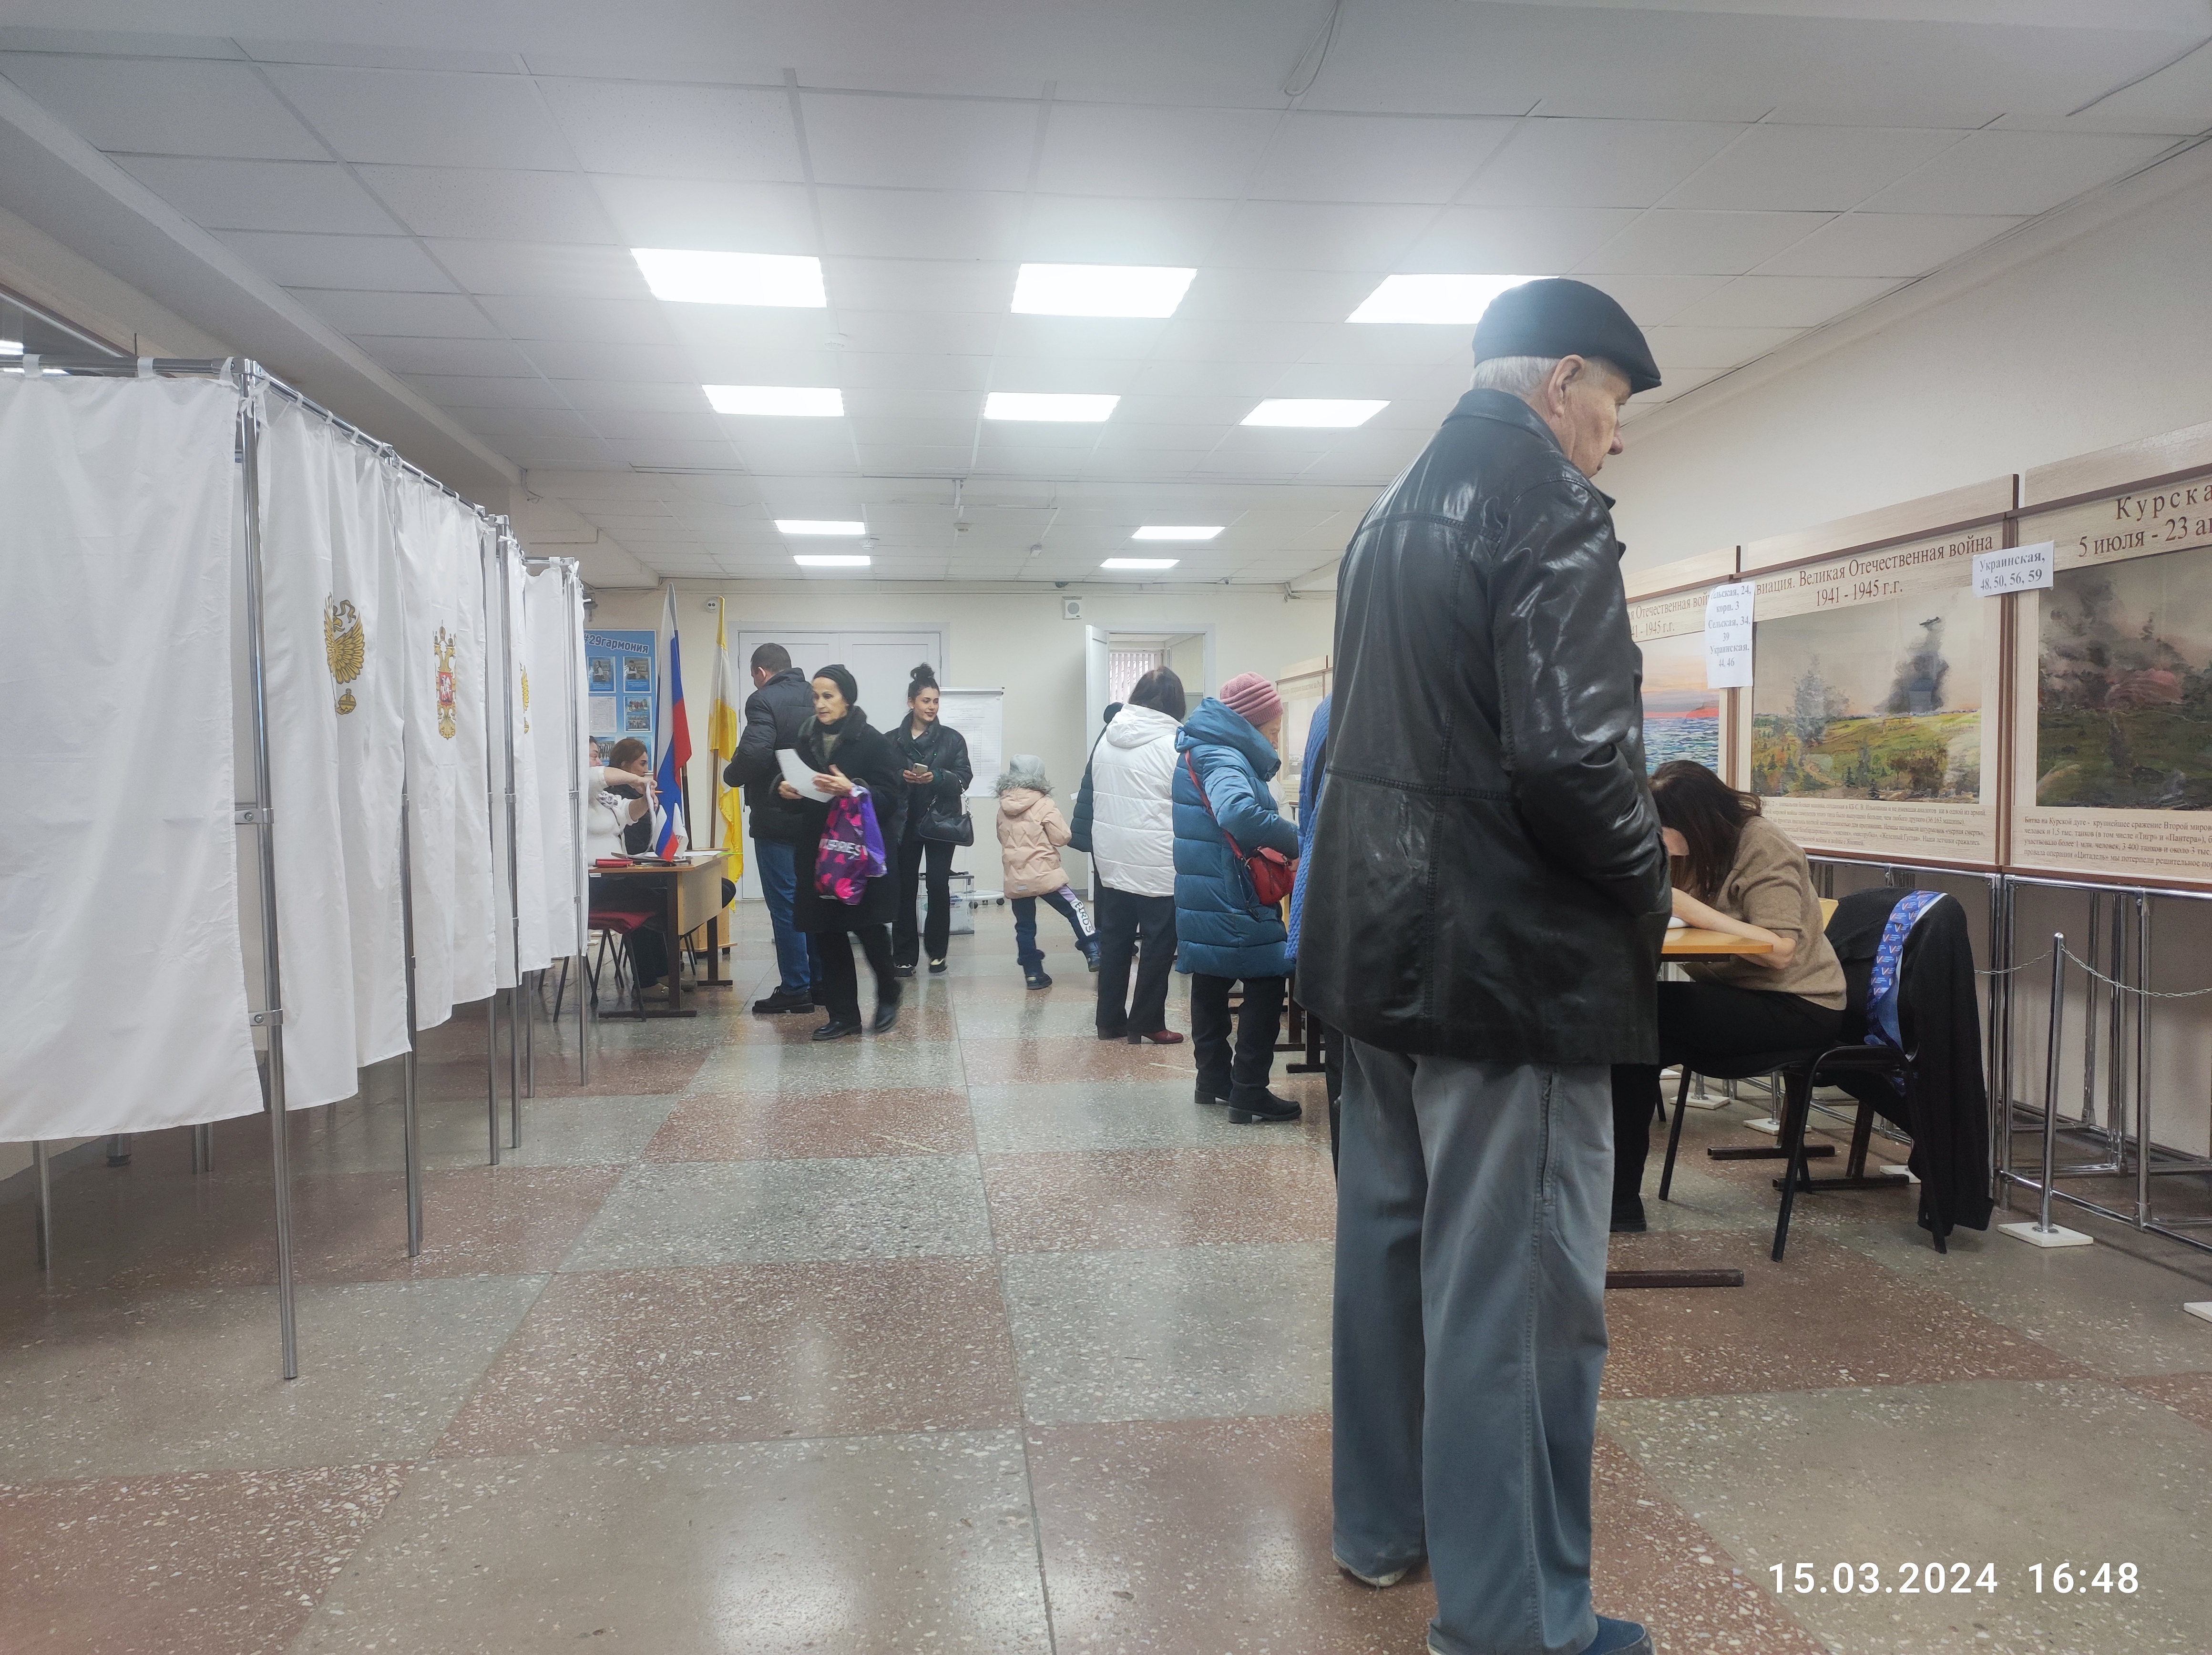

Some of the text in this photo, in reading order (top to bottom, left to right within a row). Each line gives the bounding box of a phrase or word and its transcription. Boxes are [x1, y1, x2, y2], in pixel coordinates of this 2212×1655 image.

[2078, 536, 2087, 557] 5
[2094, 531, 2144, 554] июля
[2165, 516, 2187, 542] 23
[1755, 535, 1993, 595] виация. Великая Отечественная война
[1979, 550, 2045, 573] Украинская,
[1980, 569, 2043, 591] 48, 50, 56, 59
[1741, 585, 1751, 595] 24,
[1816, 586, 1840, 607] 1941
[1854, 580, 1879, 600] 1945
[1883, 581, 1903, 595] г.г.
[1636, 598, 1690, 619] Отечественная
[1735, 601, 1739, 610] 3
[1646, 620, 1661, 636] 1945
[1663, 622, 1675, 633] г.г.
[1708, 619, 1738, 629] Сельская,
[1722, 632, 1730, 642] 39
[1727, 657, 1735, 667] 46
[2049, 817, 2072, 826] Курской
[2093, 820, 2130, 828] крупнейшее
[2164, 821, 2188, 831] Второй
[2135, 832, 2157, 842] «Тигр»
[2074, 851, 2109, 860] «Цитадель»
[2156, 858, 2200, 867] решительное
